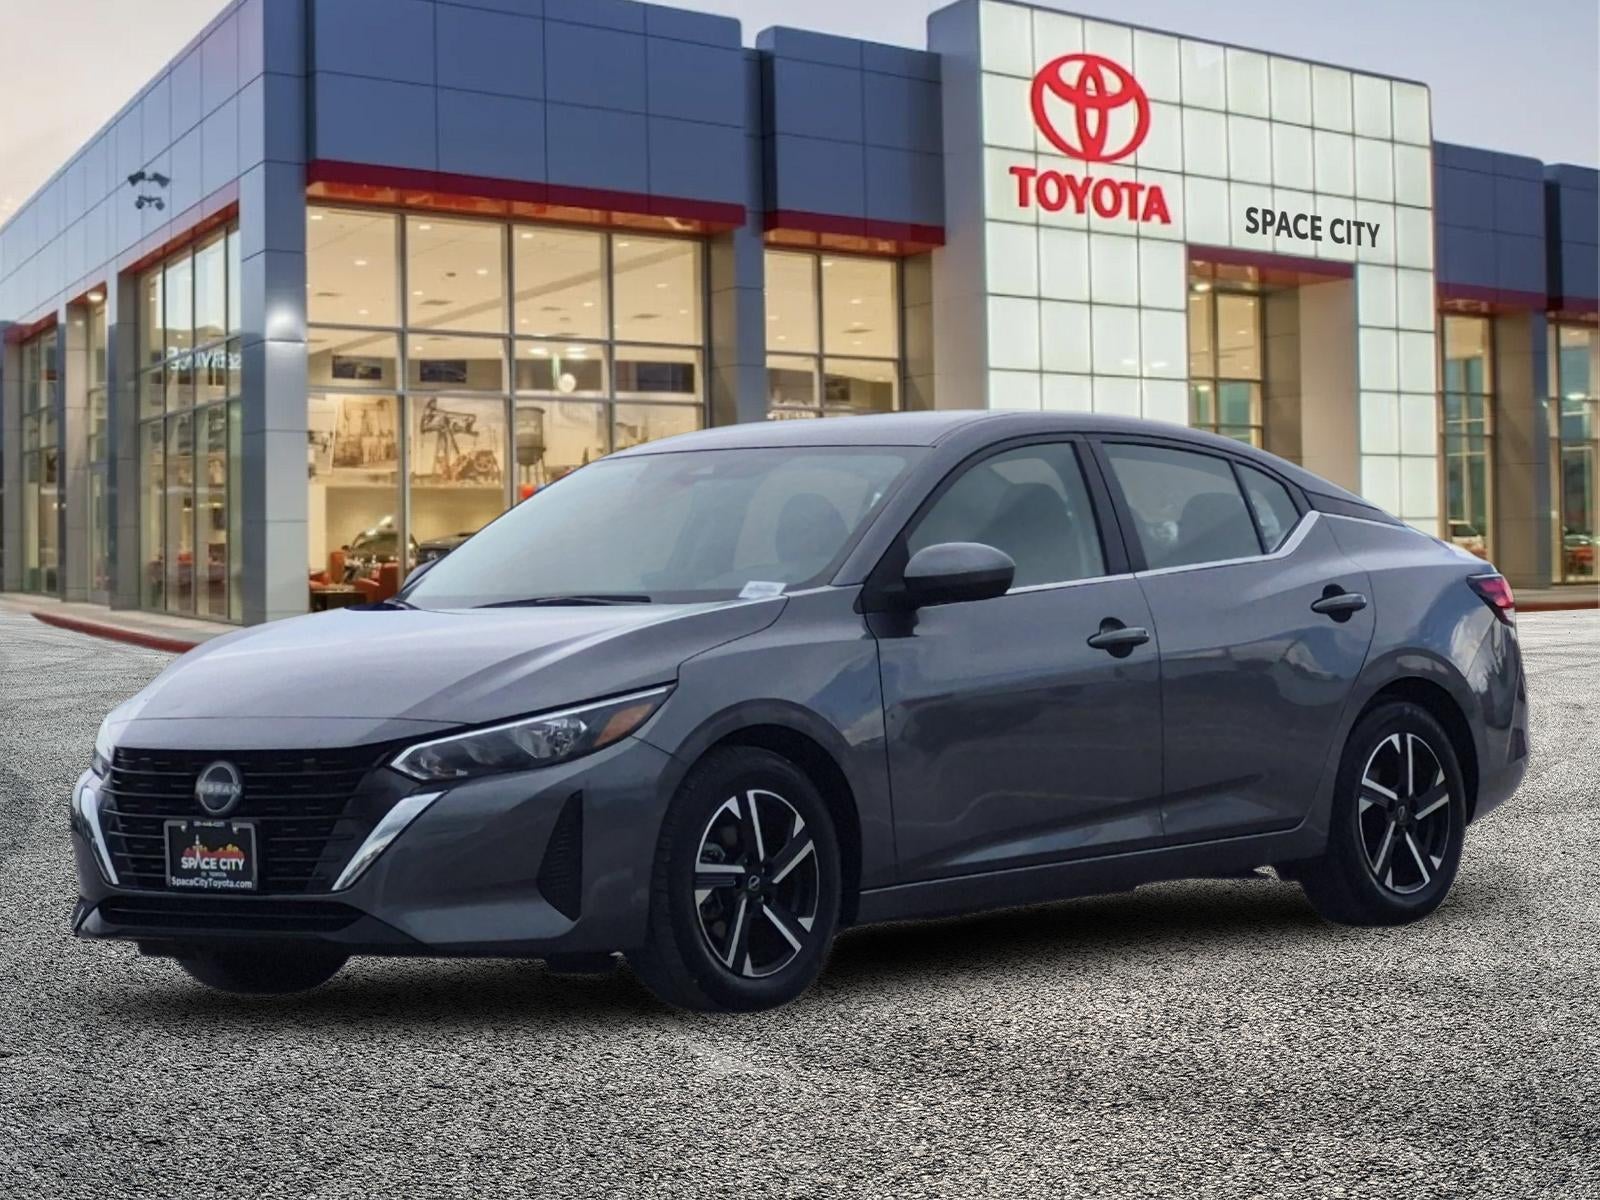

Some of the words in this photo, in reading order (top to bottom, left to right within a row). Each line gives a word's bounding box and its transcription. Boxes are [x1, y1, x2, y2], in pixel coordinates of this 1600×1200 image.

[1009, 166, 1171, 225] TOYOTA
[1245, 206, 1322, 242] SPACE
[1329, 218, 1380, 248] CITY
[197, 783, 241, 794] SSAN
[181, 857, 217, 869] SPACE
[219, 858, 245, 870] CITY
[171, 875, 252, 888] SpaceCityToyota.com
